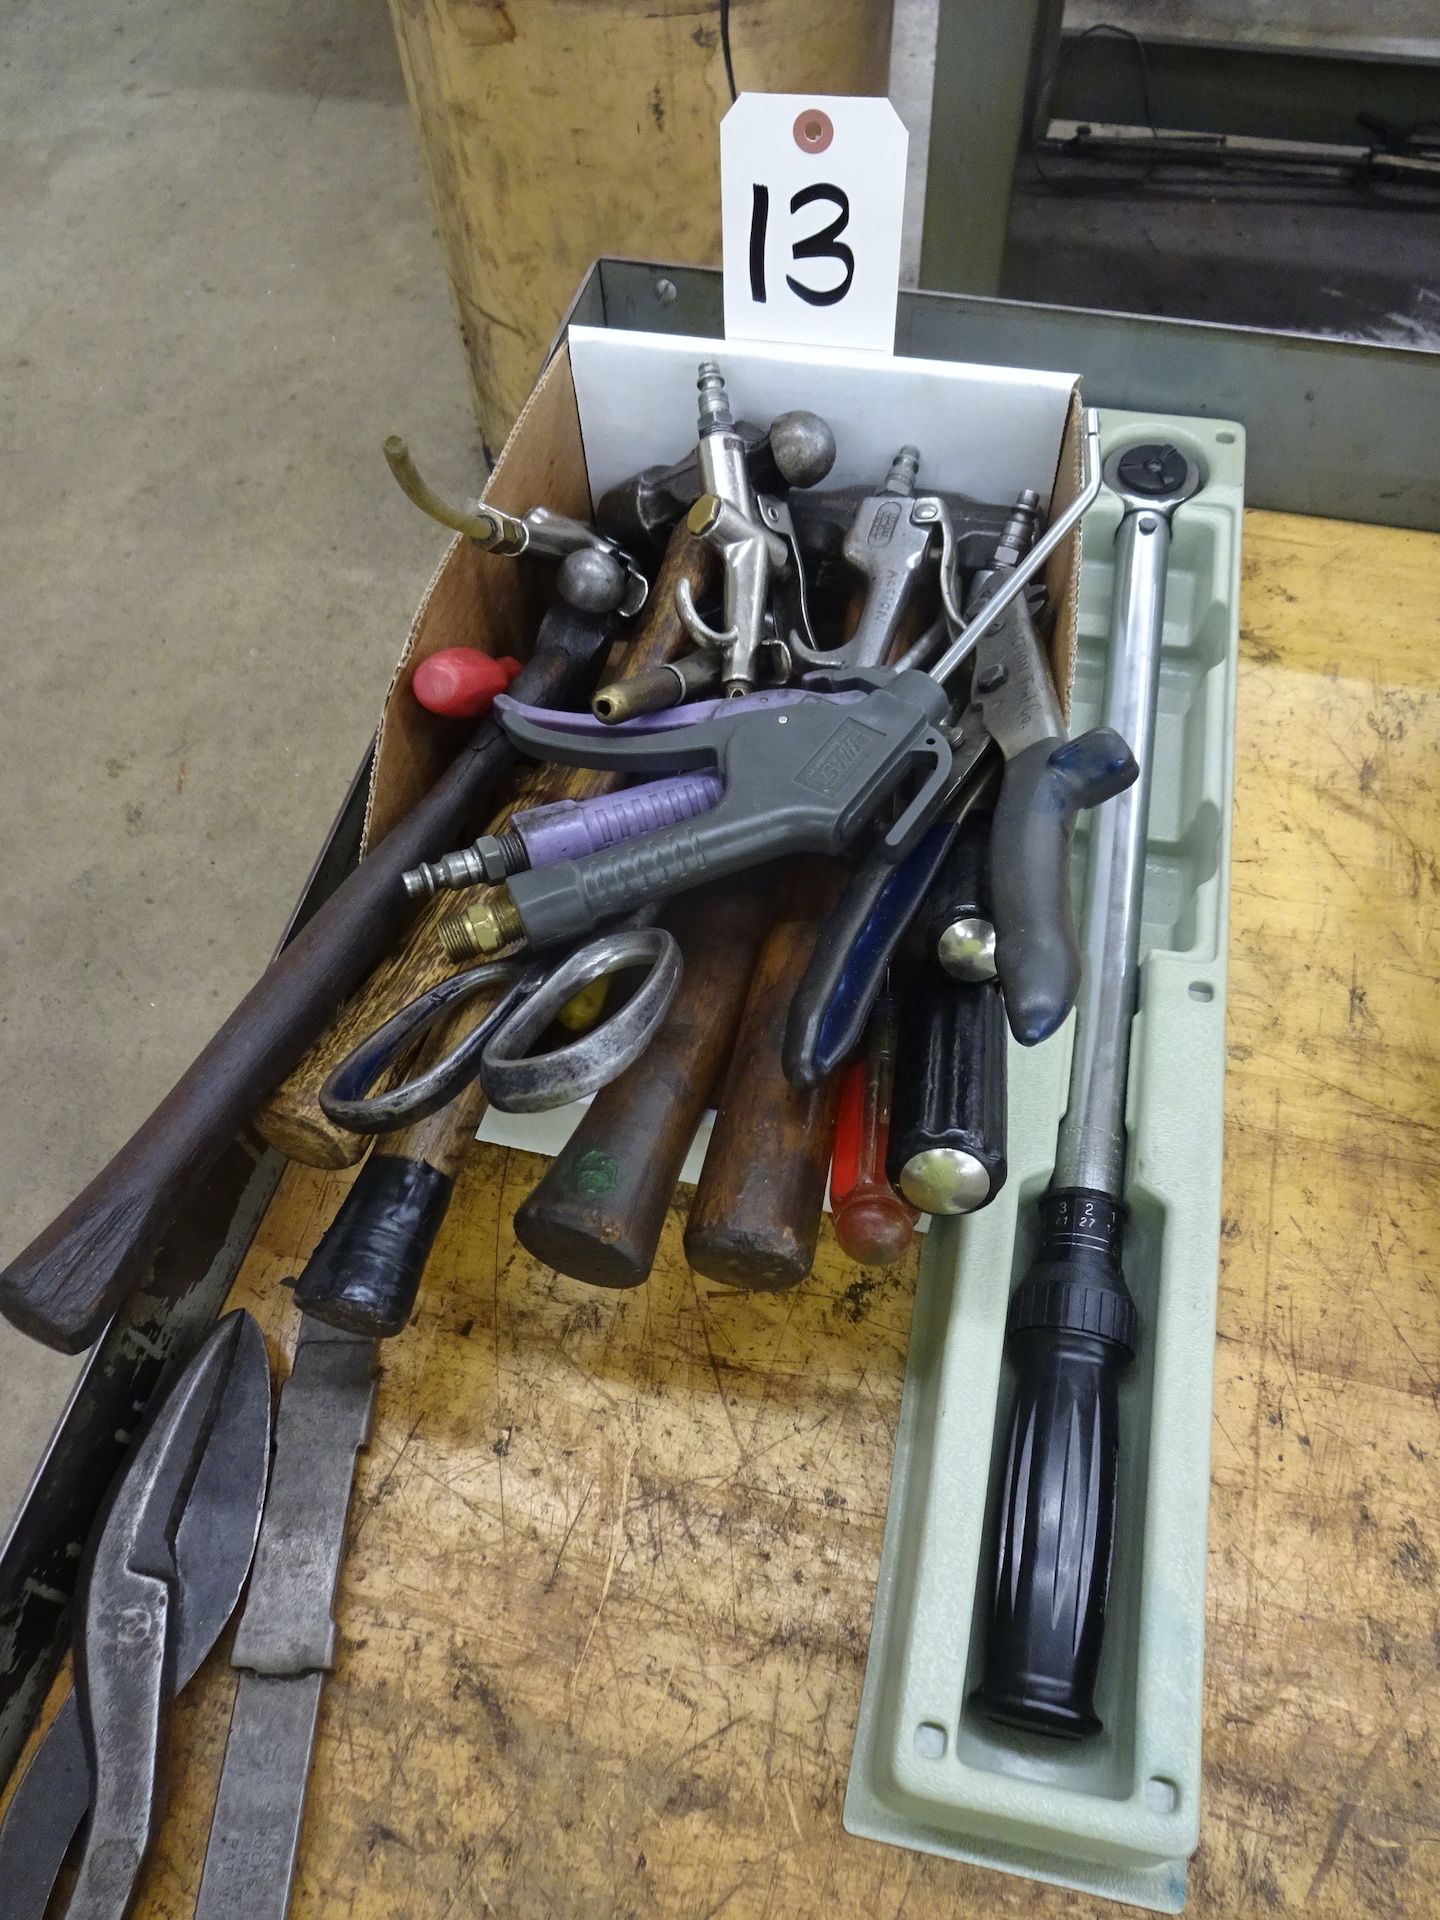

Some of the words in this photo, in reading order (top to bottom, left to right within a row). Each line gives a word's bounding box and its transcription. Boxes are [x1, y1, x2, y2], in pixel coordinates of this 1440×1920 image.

[749, 182, 855, 307] 13
[1059, 1201, 1067, 1214] 3
[1085, 1203, 1094, 1216] 2
[1111, 1211, 1117, 1223] 1
[1079, 1216, 1096, 1228] 27
